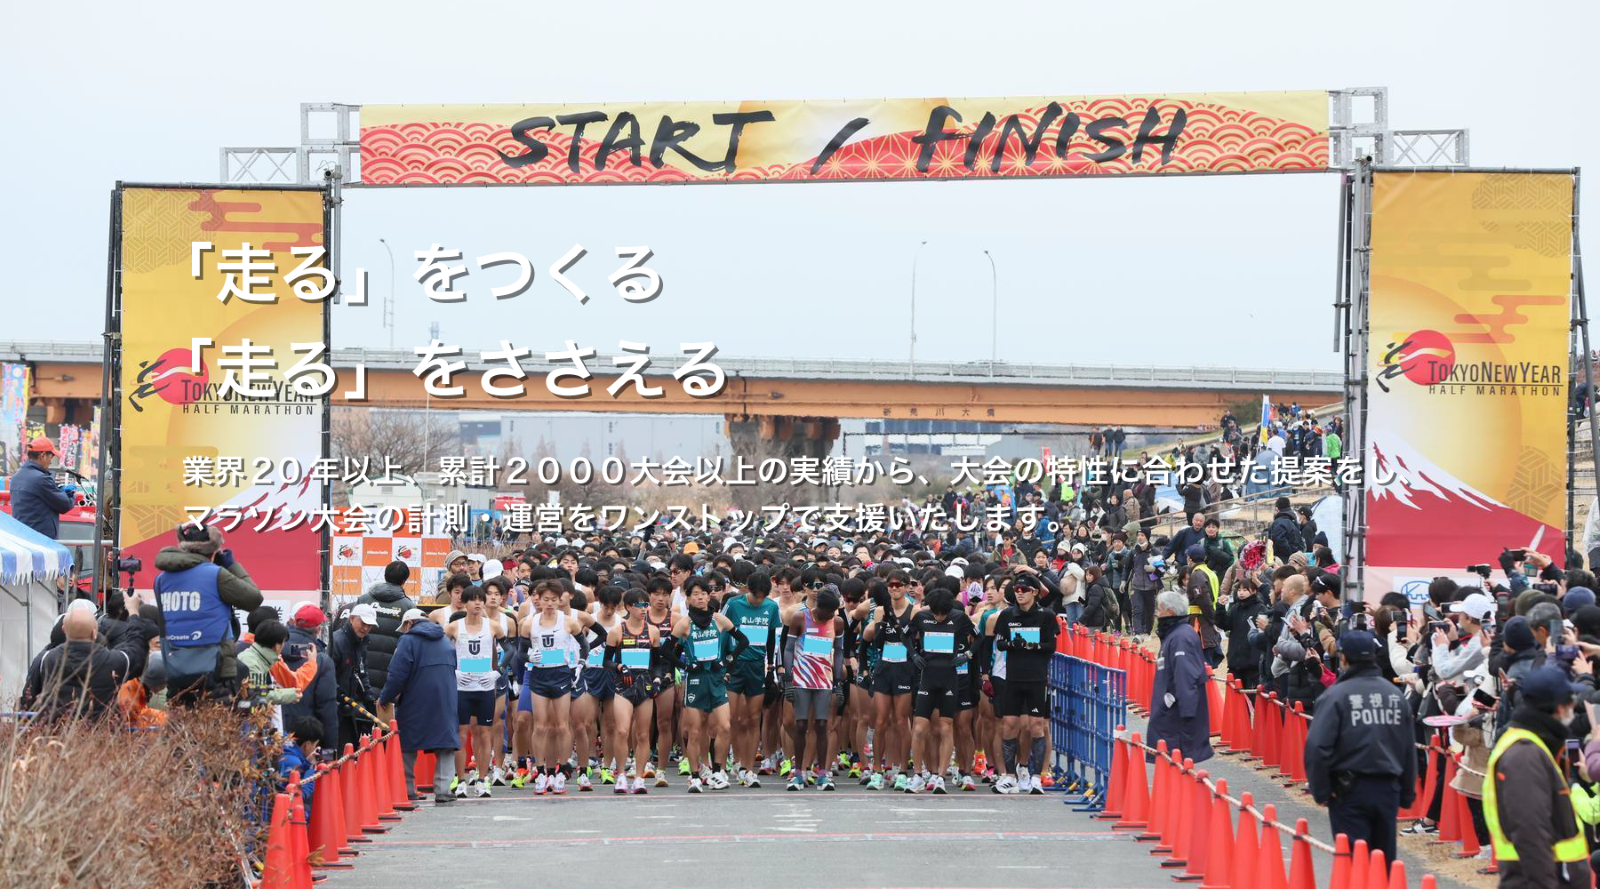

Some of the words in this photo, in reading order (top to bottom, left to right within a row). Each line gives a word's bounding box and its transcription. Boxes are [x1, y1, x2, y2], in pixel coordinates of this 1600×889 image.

[497, 111, 776, 174] START
[911, 101, 1188, 175] FINISH
[1428, 385, 1466, 396] HALF
[1476, 385, 1560, 397] MARATHON
[182, 404, 220, 415] HALF
[230, 404, 314, 416] MARATHON
[1348, 694, 1401, 710] 警視庁
[1350, 709, 1402, 727] POLICE
